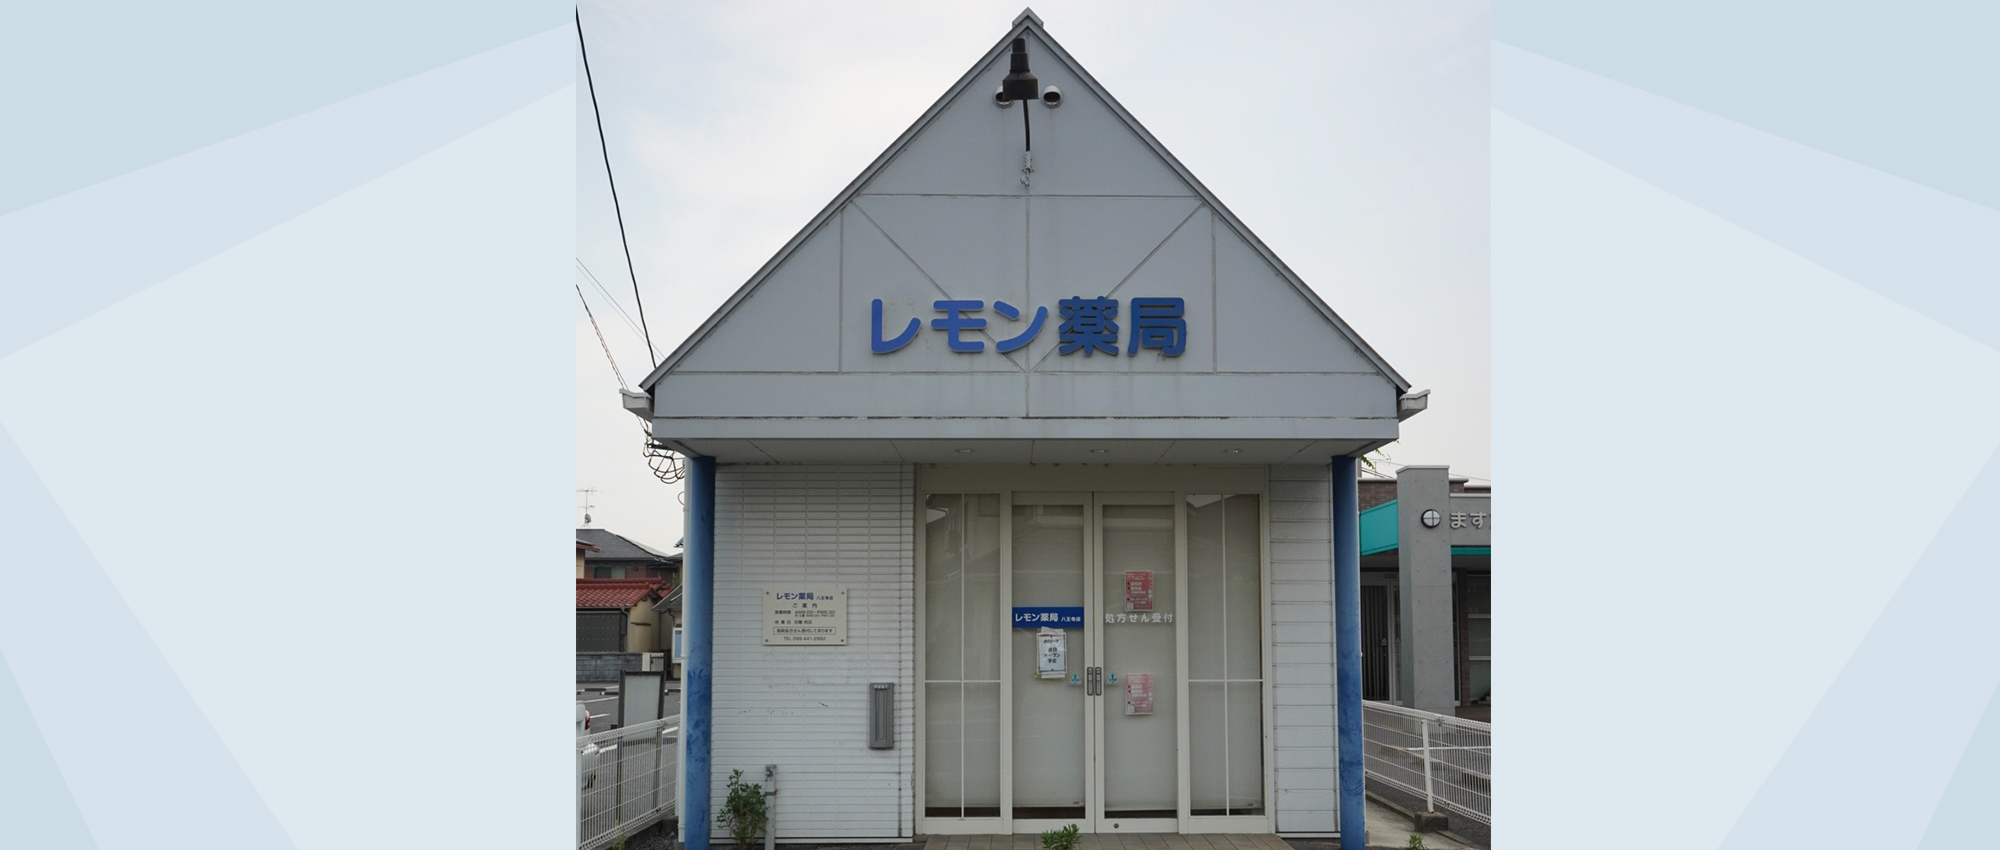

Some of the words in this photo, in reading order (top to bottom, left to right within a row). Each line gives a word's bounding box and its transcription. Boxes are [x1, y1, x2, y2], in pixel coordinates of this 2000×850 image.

[871, 295, 1187, 357] レモン薬局
[1450, 511, 1491, 529] ます
[776, 592, 814, 600] レモン薬局
[1015, 613, 1059, 622] レモン薬局
[1105, 612, 1173, 623] 処方せん受付
